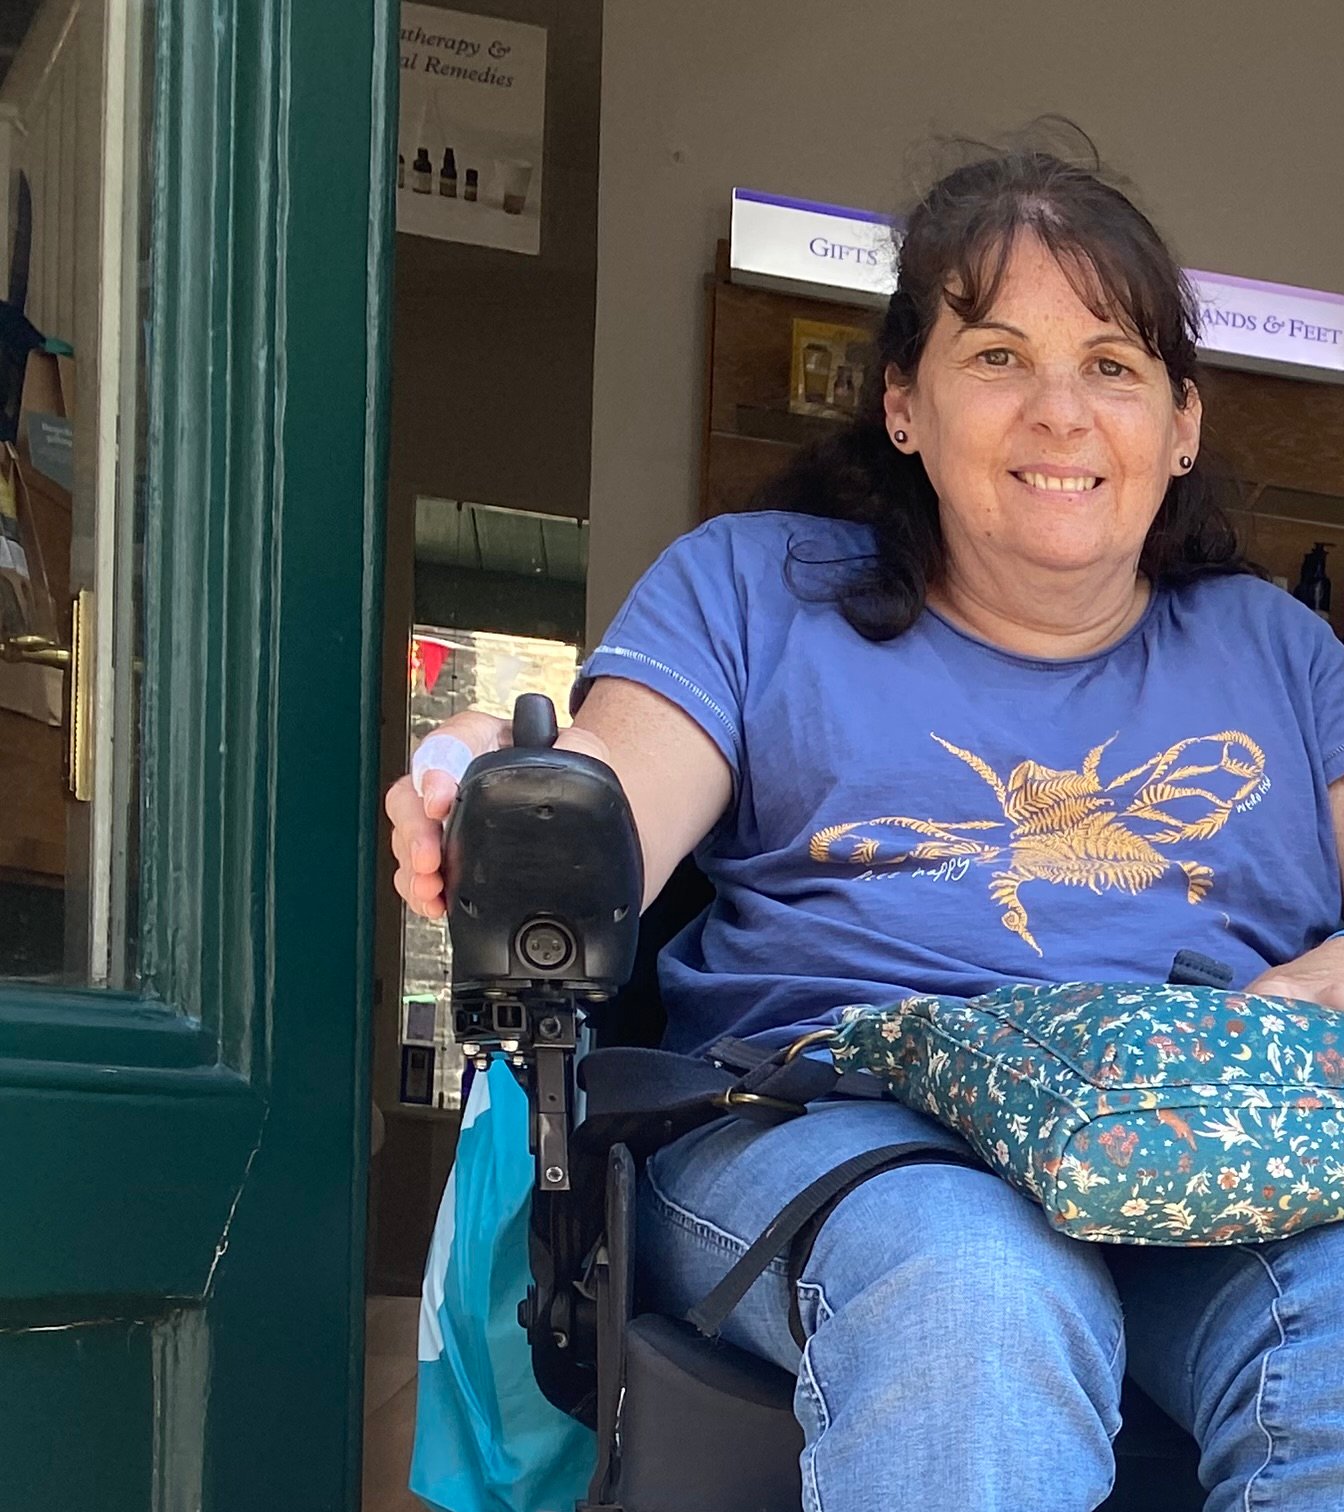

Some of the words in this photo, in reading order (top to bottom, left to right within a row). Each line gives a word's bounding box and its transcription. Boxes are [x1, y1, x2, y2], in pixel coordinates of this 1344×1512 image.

[488, 40, 511, 58] &
[425, 56, 514, 87] Remedies
[809, 236, 879, 266] GIFTS
[1200, 308, 1258, 331] ANDS
[1263, 315, 1285, 334] &
[1288, 318, 1343, 345] FEET
